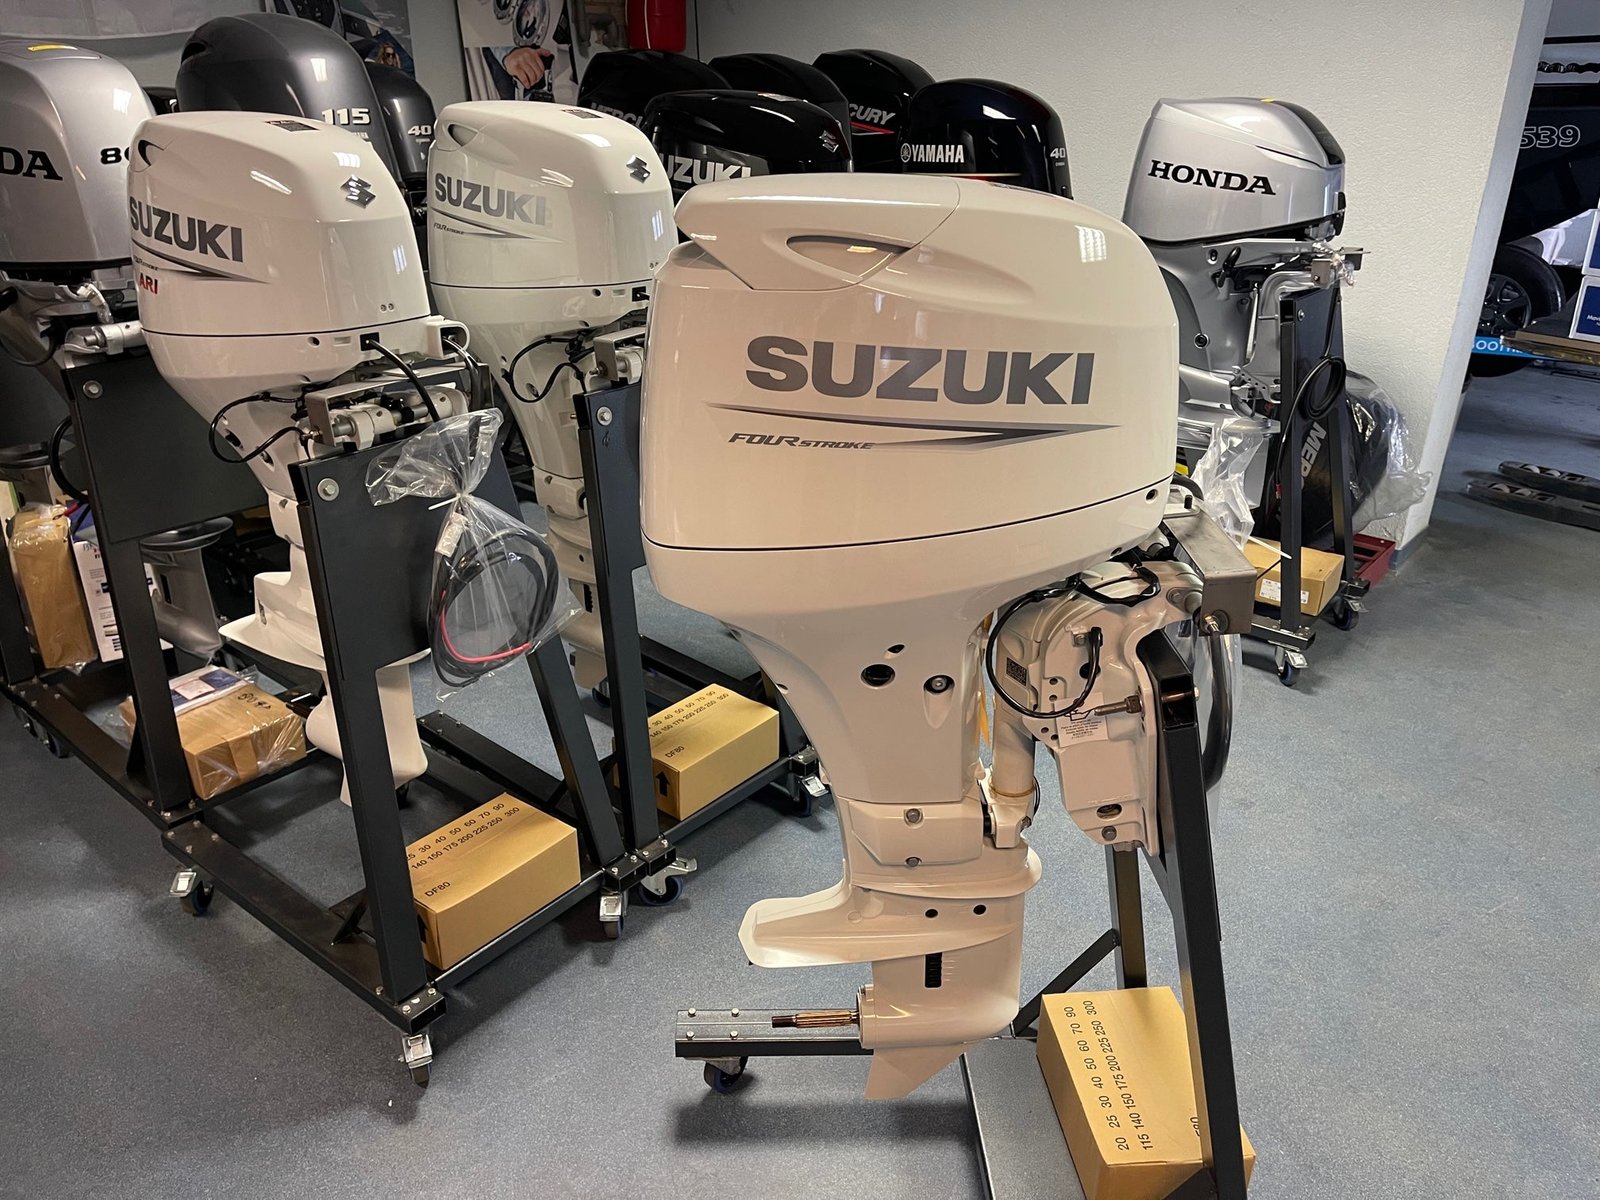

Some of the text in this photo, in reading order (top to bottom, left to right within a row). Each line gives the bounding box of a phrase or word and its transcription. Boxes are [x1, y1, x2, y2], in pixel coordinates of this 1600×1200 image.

[321, 107, 371, 125] 115
[407, 125, 432, 136] 40
[100, 147, 130, 165] 8
[911, 144, 965, 163] YAMAHA
[1050, 147, 1066, 159] 40
[1148, 159, 1276, 195] HONDA
[435, 172, 546, 226] SUZUKI
[129, 196, 243, 263] SUZUKI
[745, 335, 1095, 405] SUZUKI
[411, 807, 520, 869] 140 150 175 200 225 250 300
[418, 844, 431, 853] 30
[435, 835, 447, 844] 40
[449, 827, 461, 836] 50
[464, 819, 476, 827] 60
[478, 811, 491, 819] 70
[492, 803, 505, 811] 90
[424, 881, 451, 897] DF80
[1064, 1006, 1130, 1151] 20 25 30 40 50 60 70 90
[1082, 1000, 1153, 1150] 115 140 150 175 200 225 250 300
